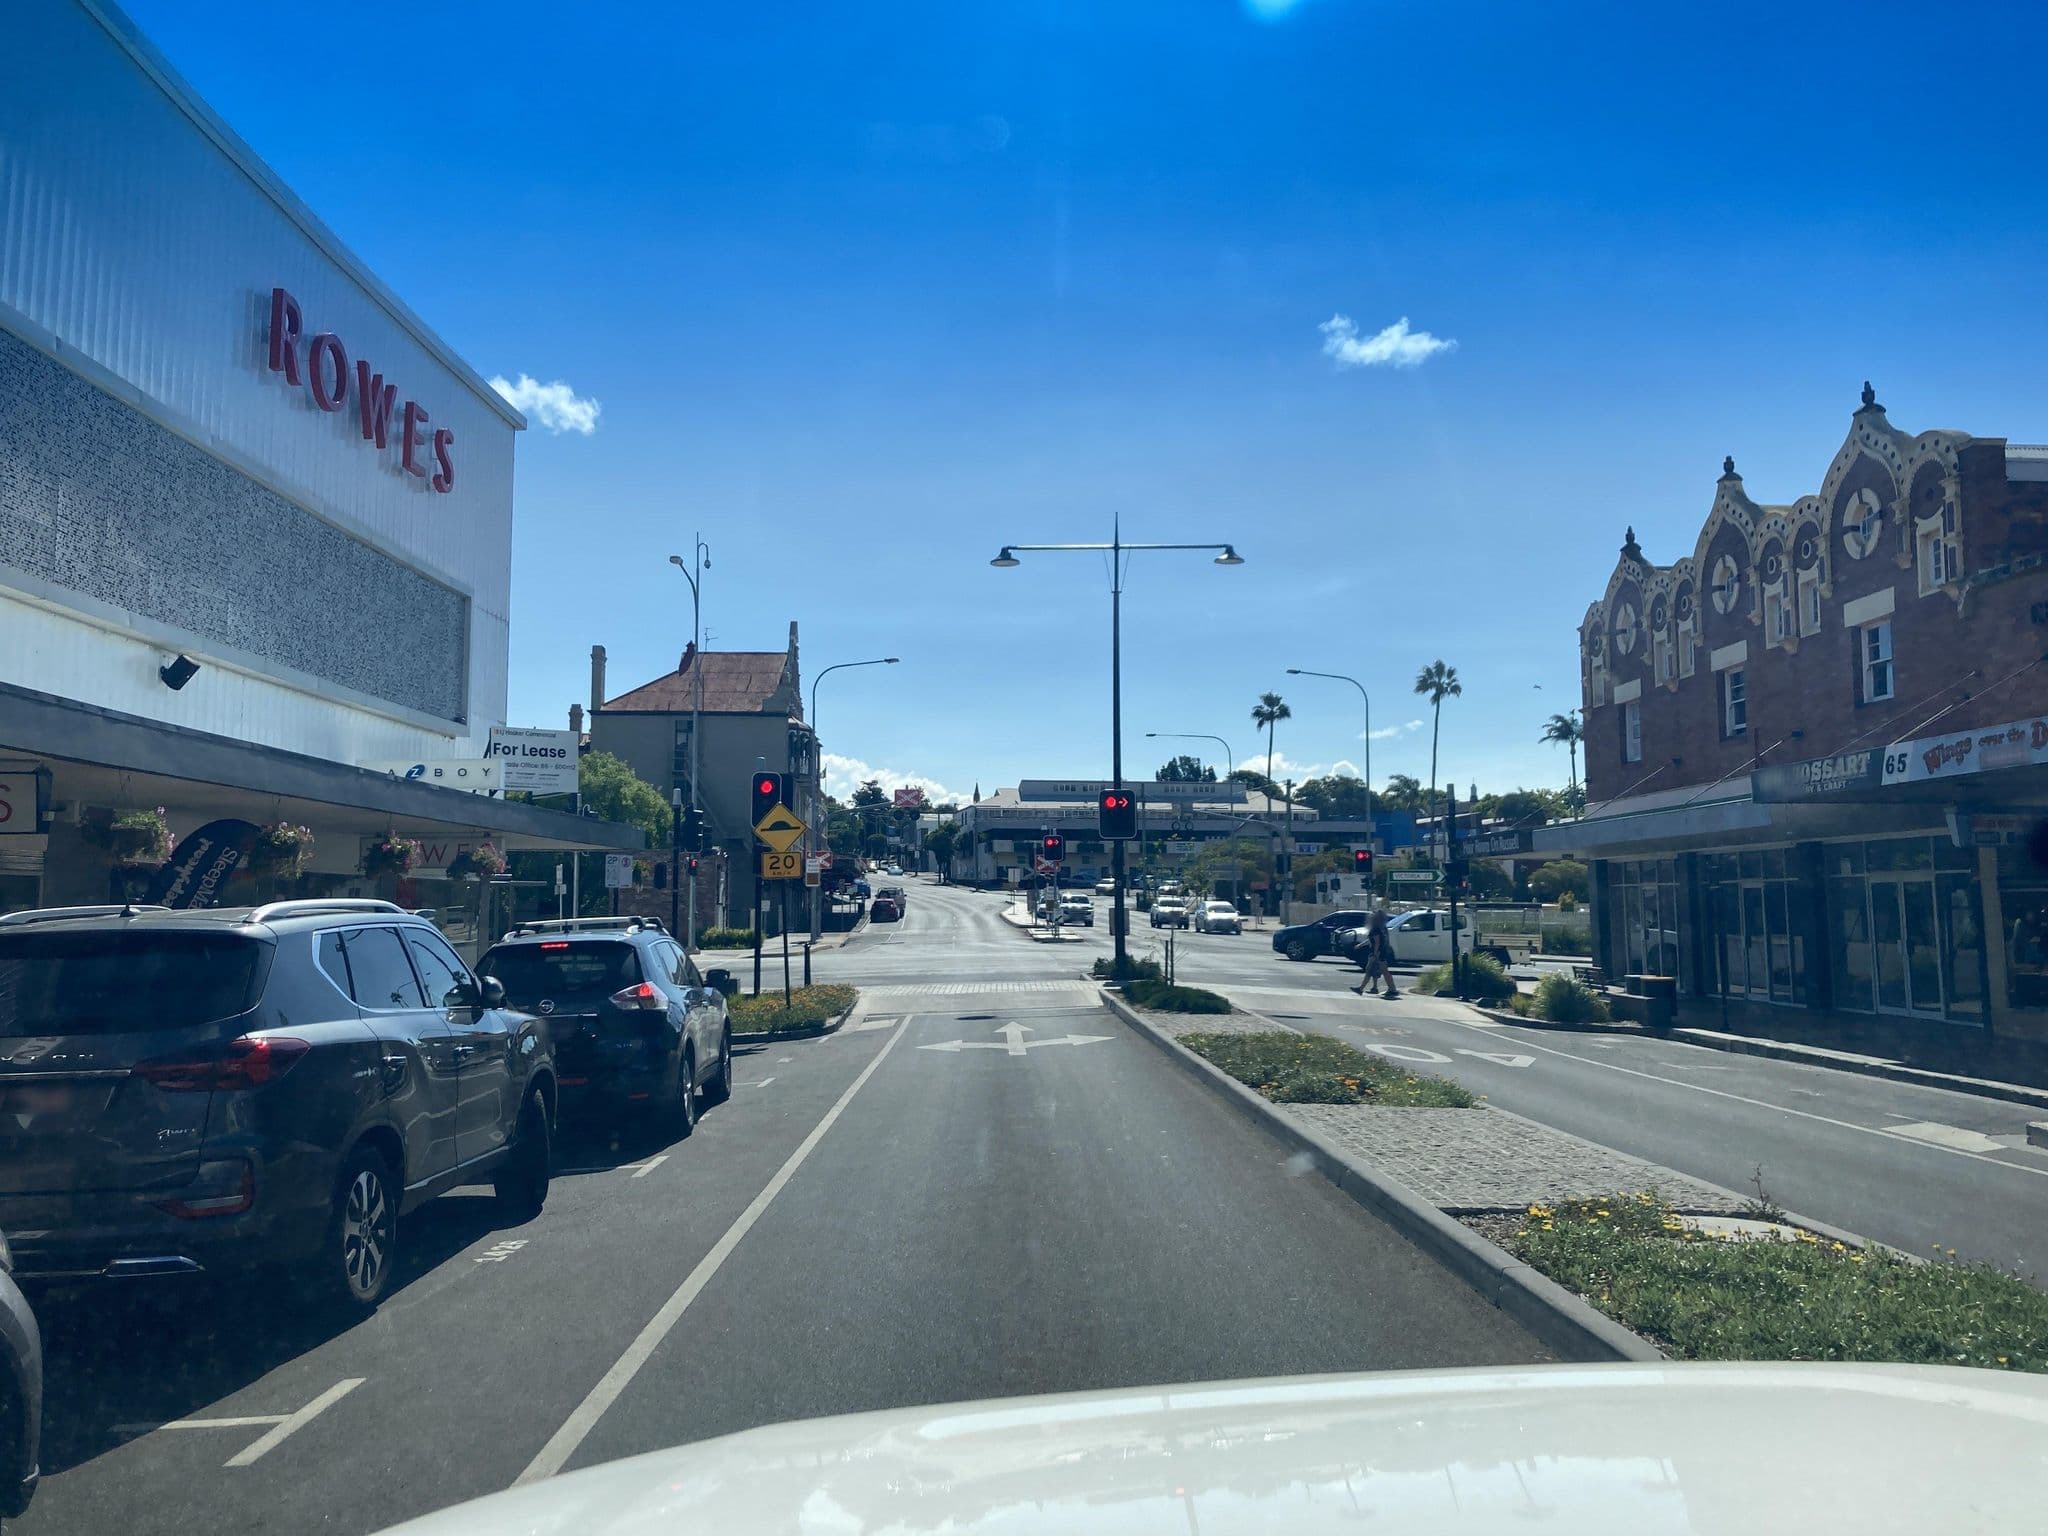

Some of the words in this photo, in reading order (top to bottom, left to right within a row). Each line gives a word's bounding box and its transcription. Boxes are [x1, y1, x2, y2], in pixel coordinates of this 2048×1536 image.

[268, 287, 454, 493] ROWES
[493, 742, 518, 756] For
[521, 744, 566, 758] Lease
[1922, 737, 1972, 775] Wings
[2031, 721, 2048, 749] D
[1886, 752, 1908, 774] 65
[769, 855, 795, 869] 20
